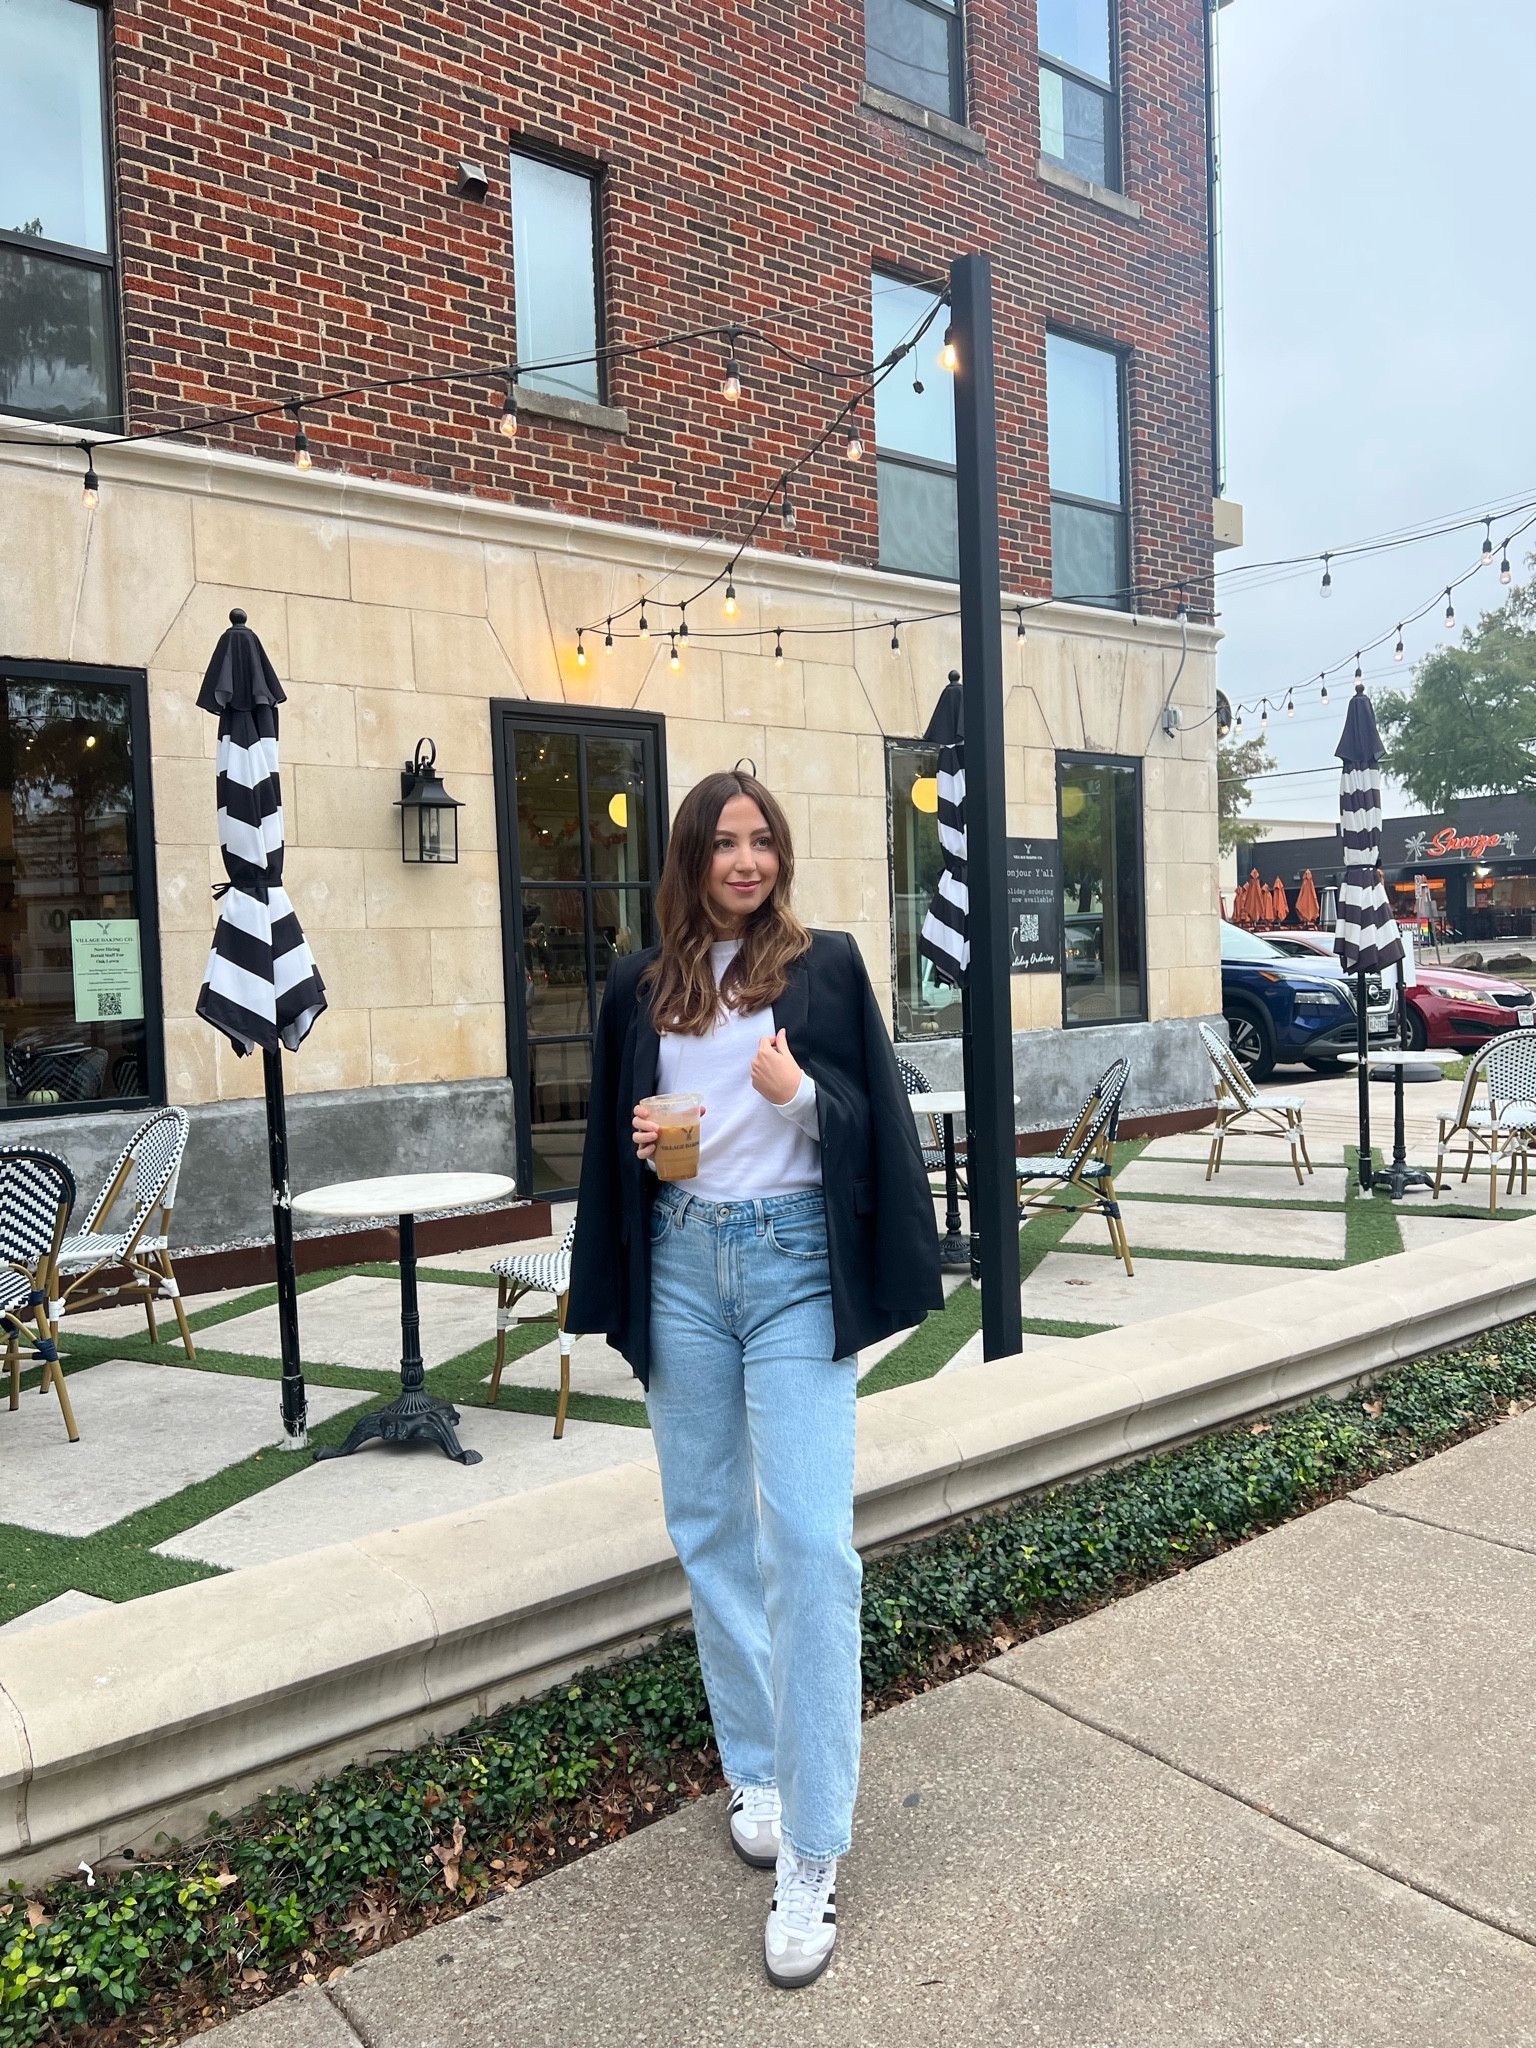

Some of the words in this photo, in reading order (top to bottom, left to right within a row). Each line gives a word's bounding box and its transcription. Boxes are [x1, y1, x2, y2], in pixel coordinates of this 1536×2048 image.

[1427, 827, 1500, 858] Snooze
[1006, 869, 1032, 878] onjour
[1035, 868, 1054, 878] Y'all
[1028, 888, 1054, 896] ordering
